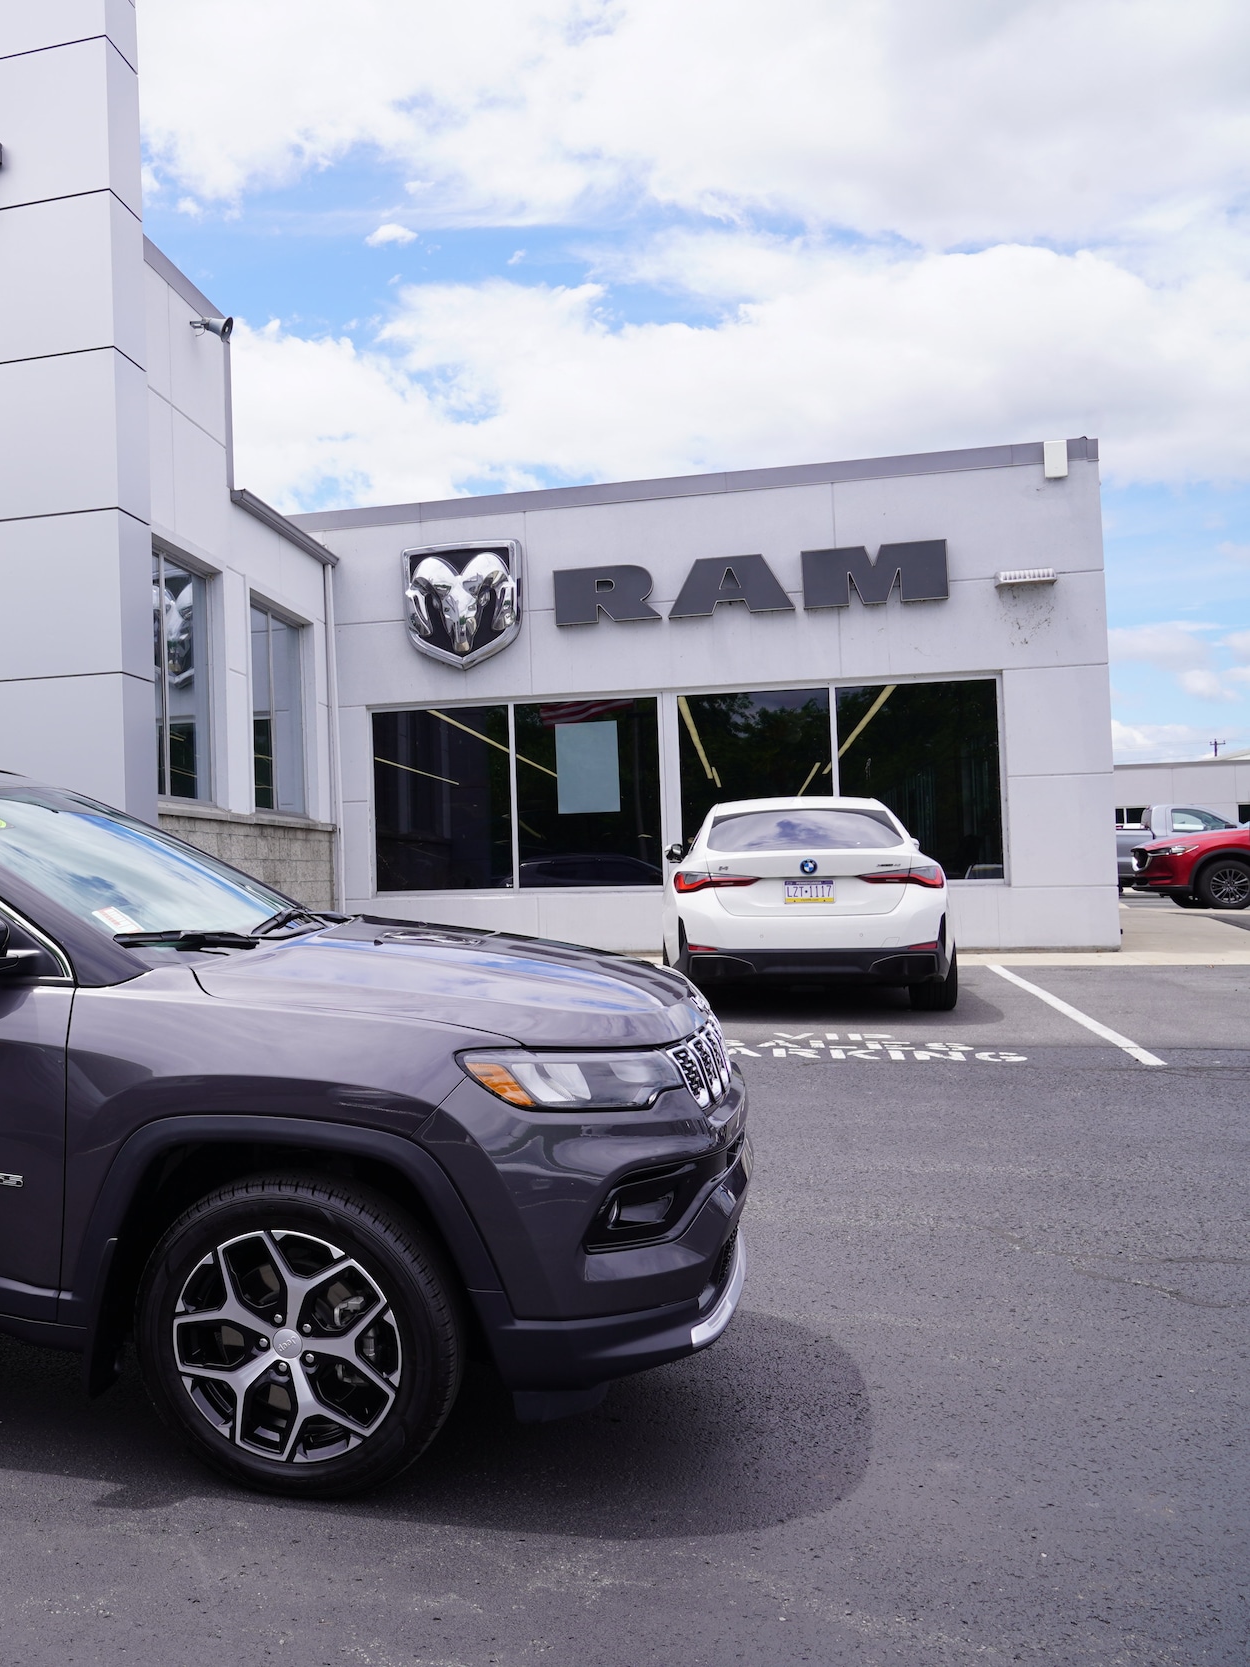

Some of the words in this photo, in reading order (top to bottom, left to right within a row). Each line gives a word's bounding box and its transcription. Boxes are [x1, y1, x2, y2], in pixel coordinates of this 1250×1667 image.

[552, 538, 949, 627] RAM
[773, 1032, 892, 1041] VIP
[727, 1046, 1028, 1062] ARKING
